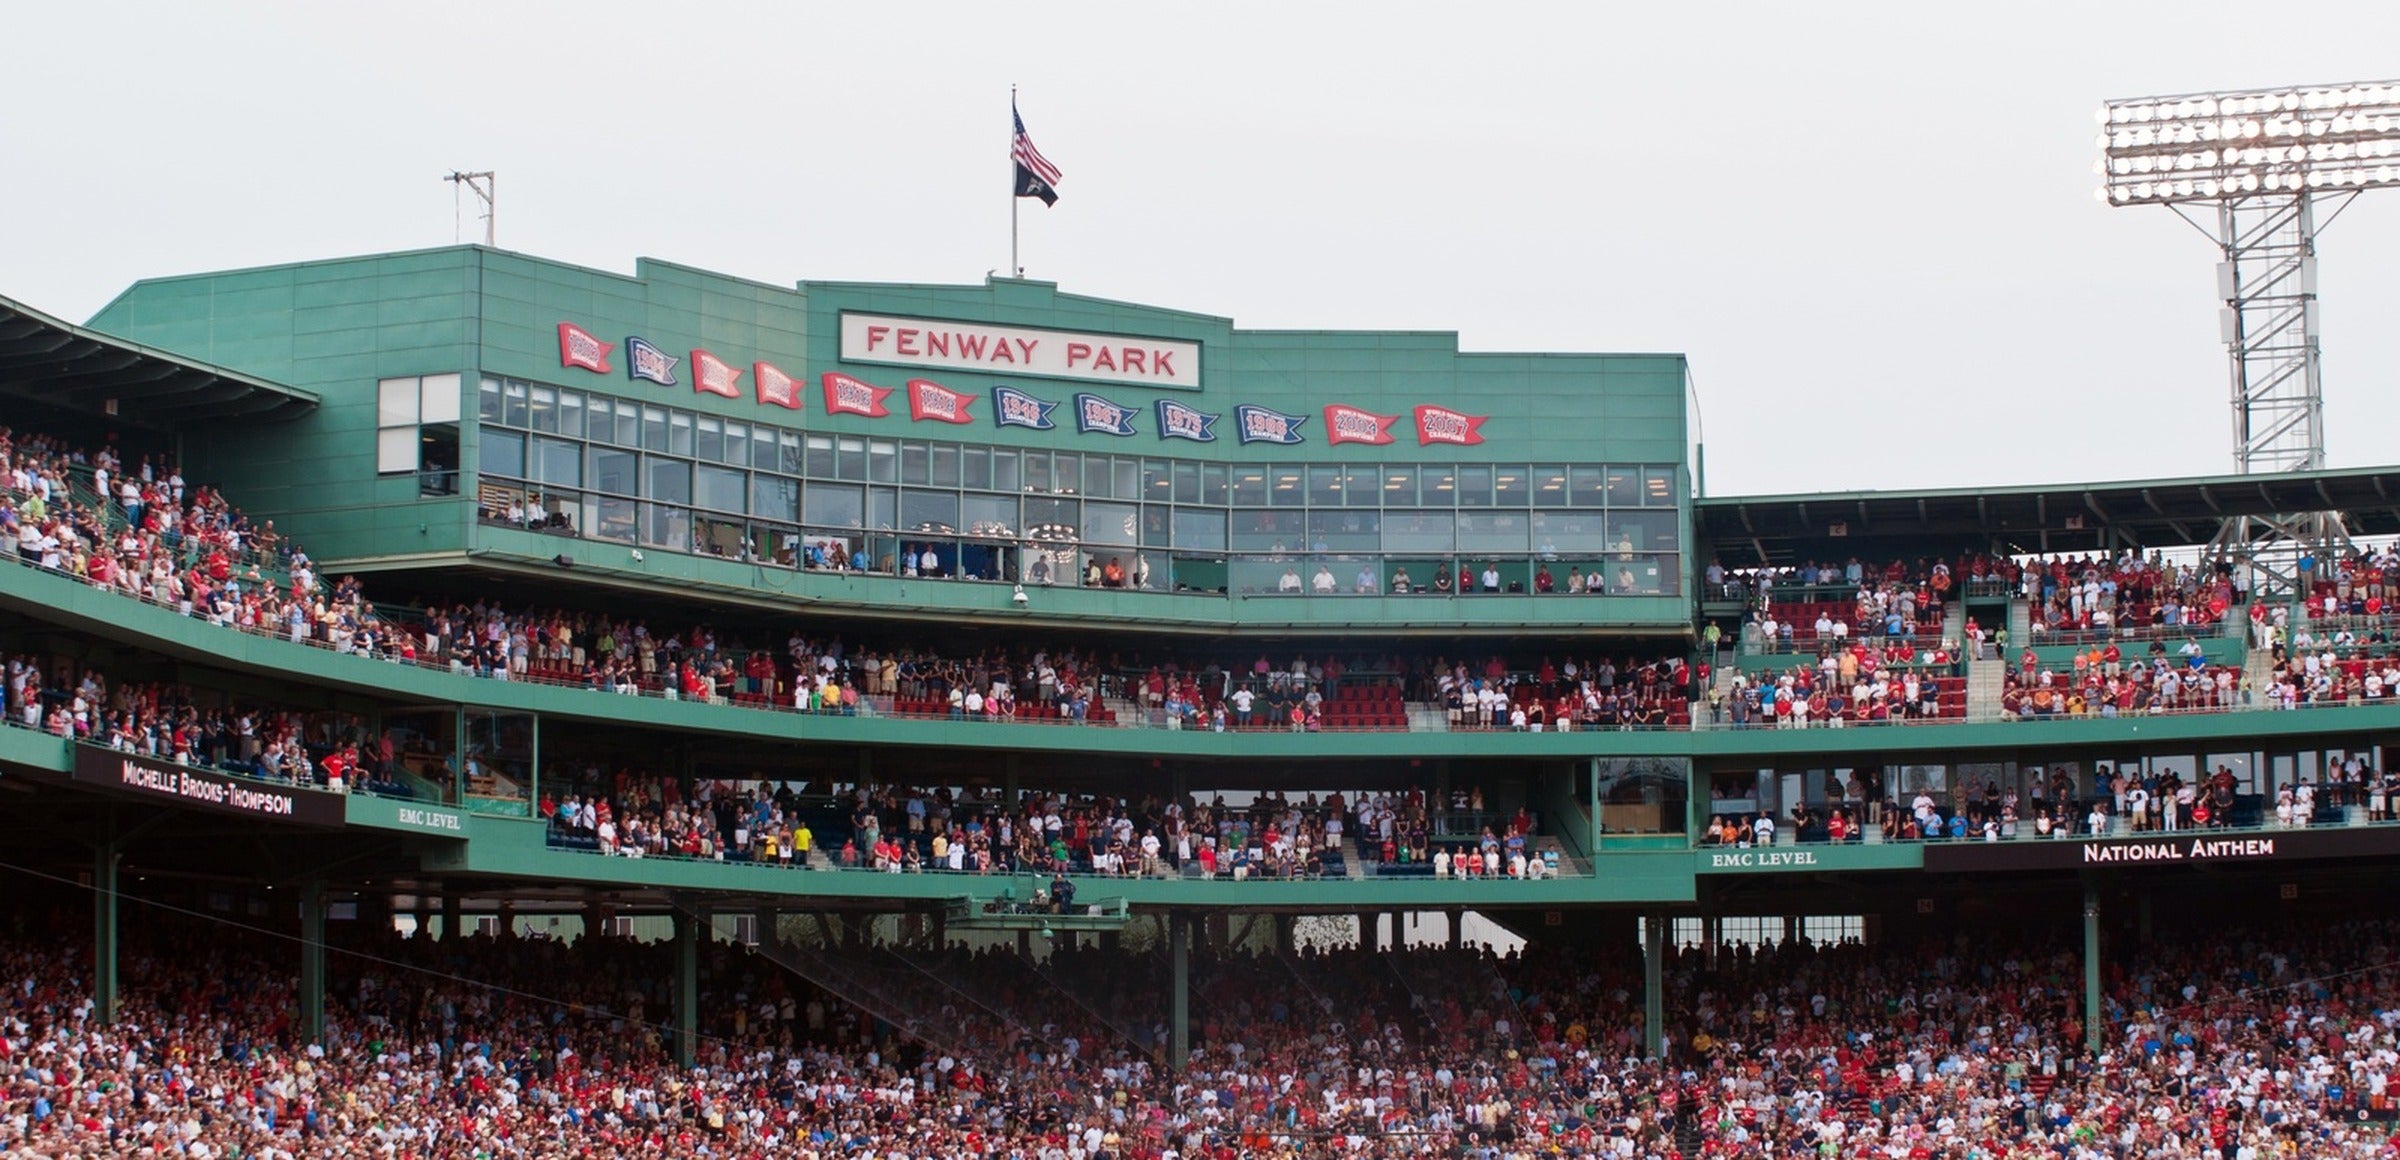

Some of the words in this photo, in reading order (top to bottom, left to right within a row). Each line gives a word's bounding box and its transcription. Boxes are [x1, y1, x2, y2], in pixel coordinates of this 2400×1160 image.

[867, 325, 1039, 365] FENWAY
[1067, 342, 1176, 377] PARK
[1003, 396, 1041, 420] 1946
[1085, 402, 1122, 427] 1967
[1166, 408, 1202, 433] 1975
[1335, 414, 1378, 435] 2004
[1423, 414, 1469, 435] 2007
[399, 808, 424, 825] EMC
[426, 811, 461, 830] LEVEL
[1712, 853, 1753, 867] EMC
[1758, 852, 1817, 865] LEVEL
[2084, 843, 2183, 862] NATIONAL
[2190, 838, 2274, 858] ANTHEM
